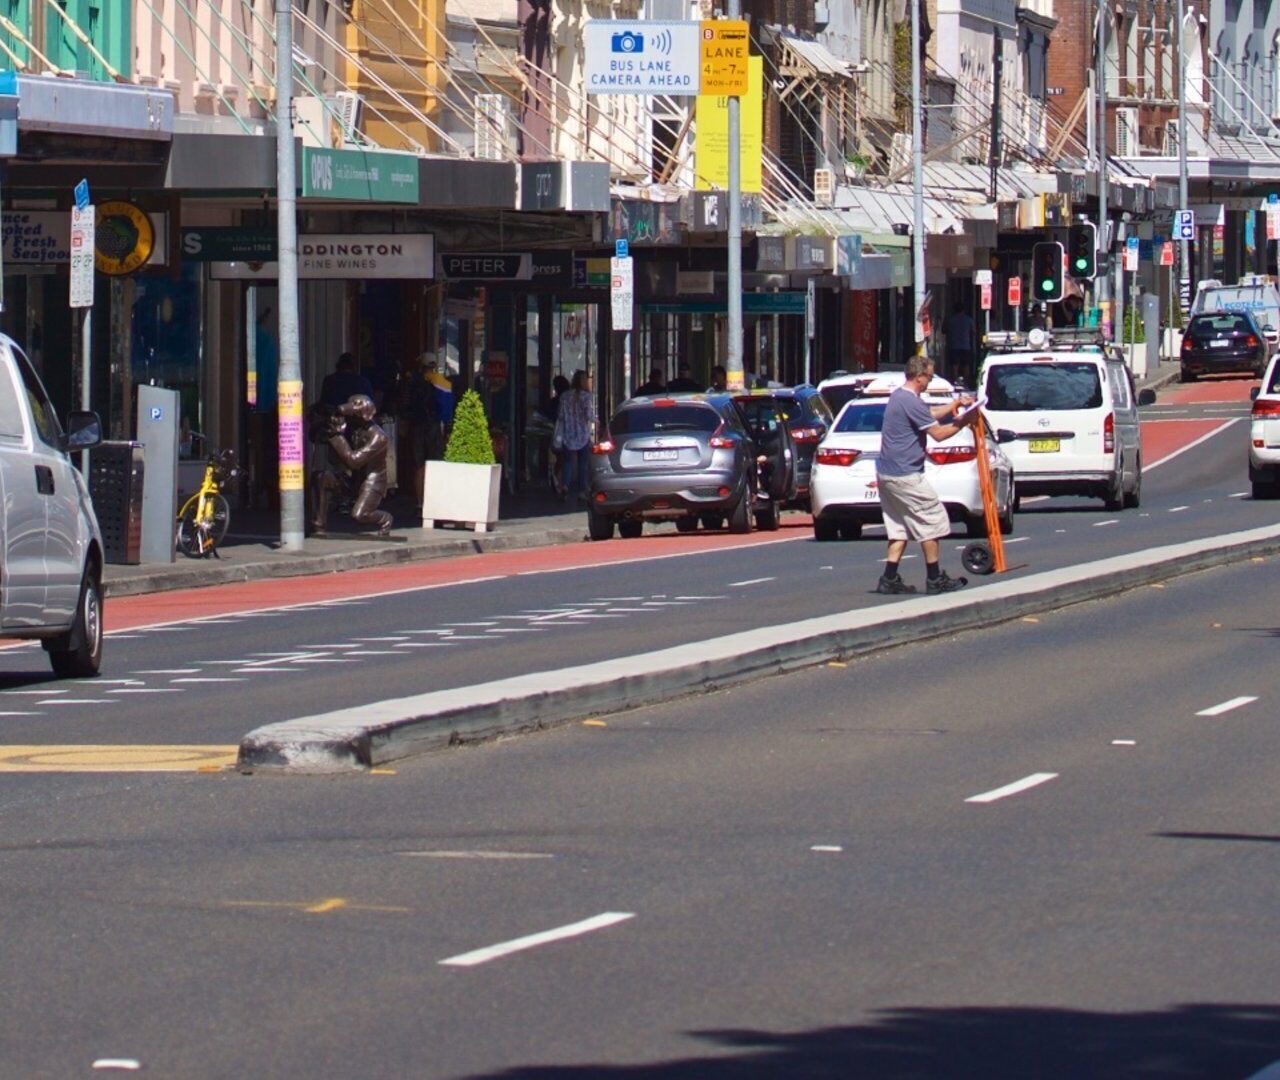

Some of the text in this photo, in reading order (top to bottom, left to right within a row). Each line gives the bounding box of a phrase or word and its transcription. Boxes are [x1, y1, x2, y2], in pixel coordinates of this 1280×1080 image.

[706, 48, 743, 59] LANE
[610, 60, 671, 72] BUS LANE
[591, 74, 690, 85] CAMERA AHEAD
[311, 154, 333, 190] OPUS
[297, 244, 403, 256] DDINGTON
[304, 259, 377, 269] FINE WINES
[450, 258, 505, 273] PETER
